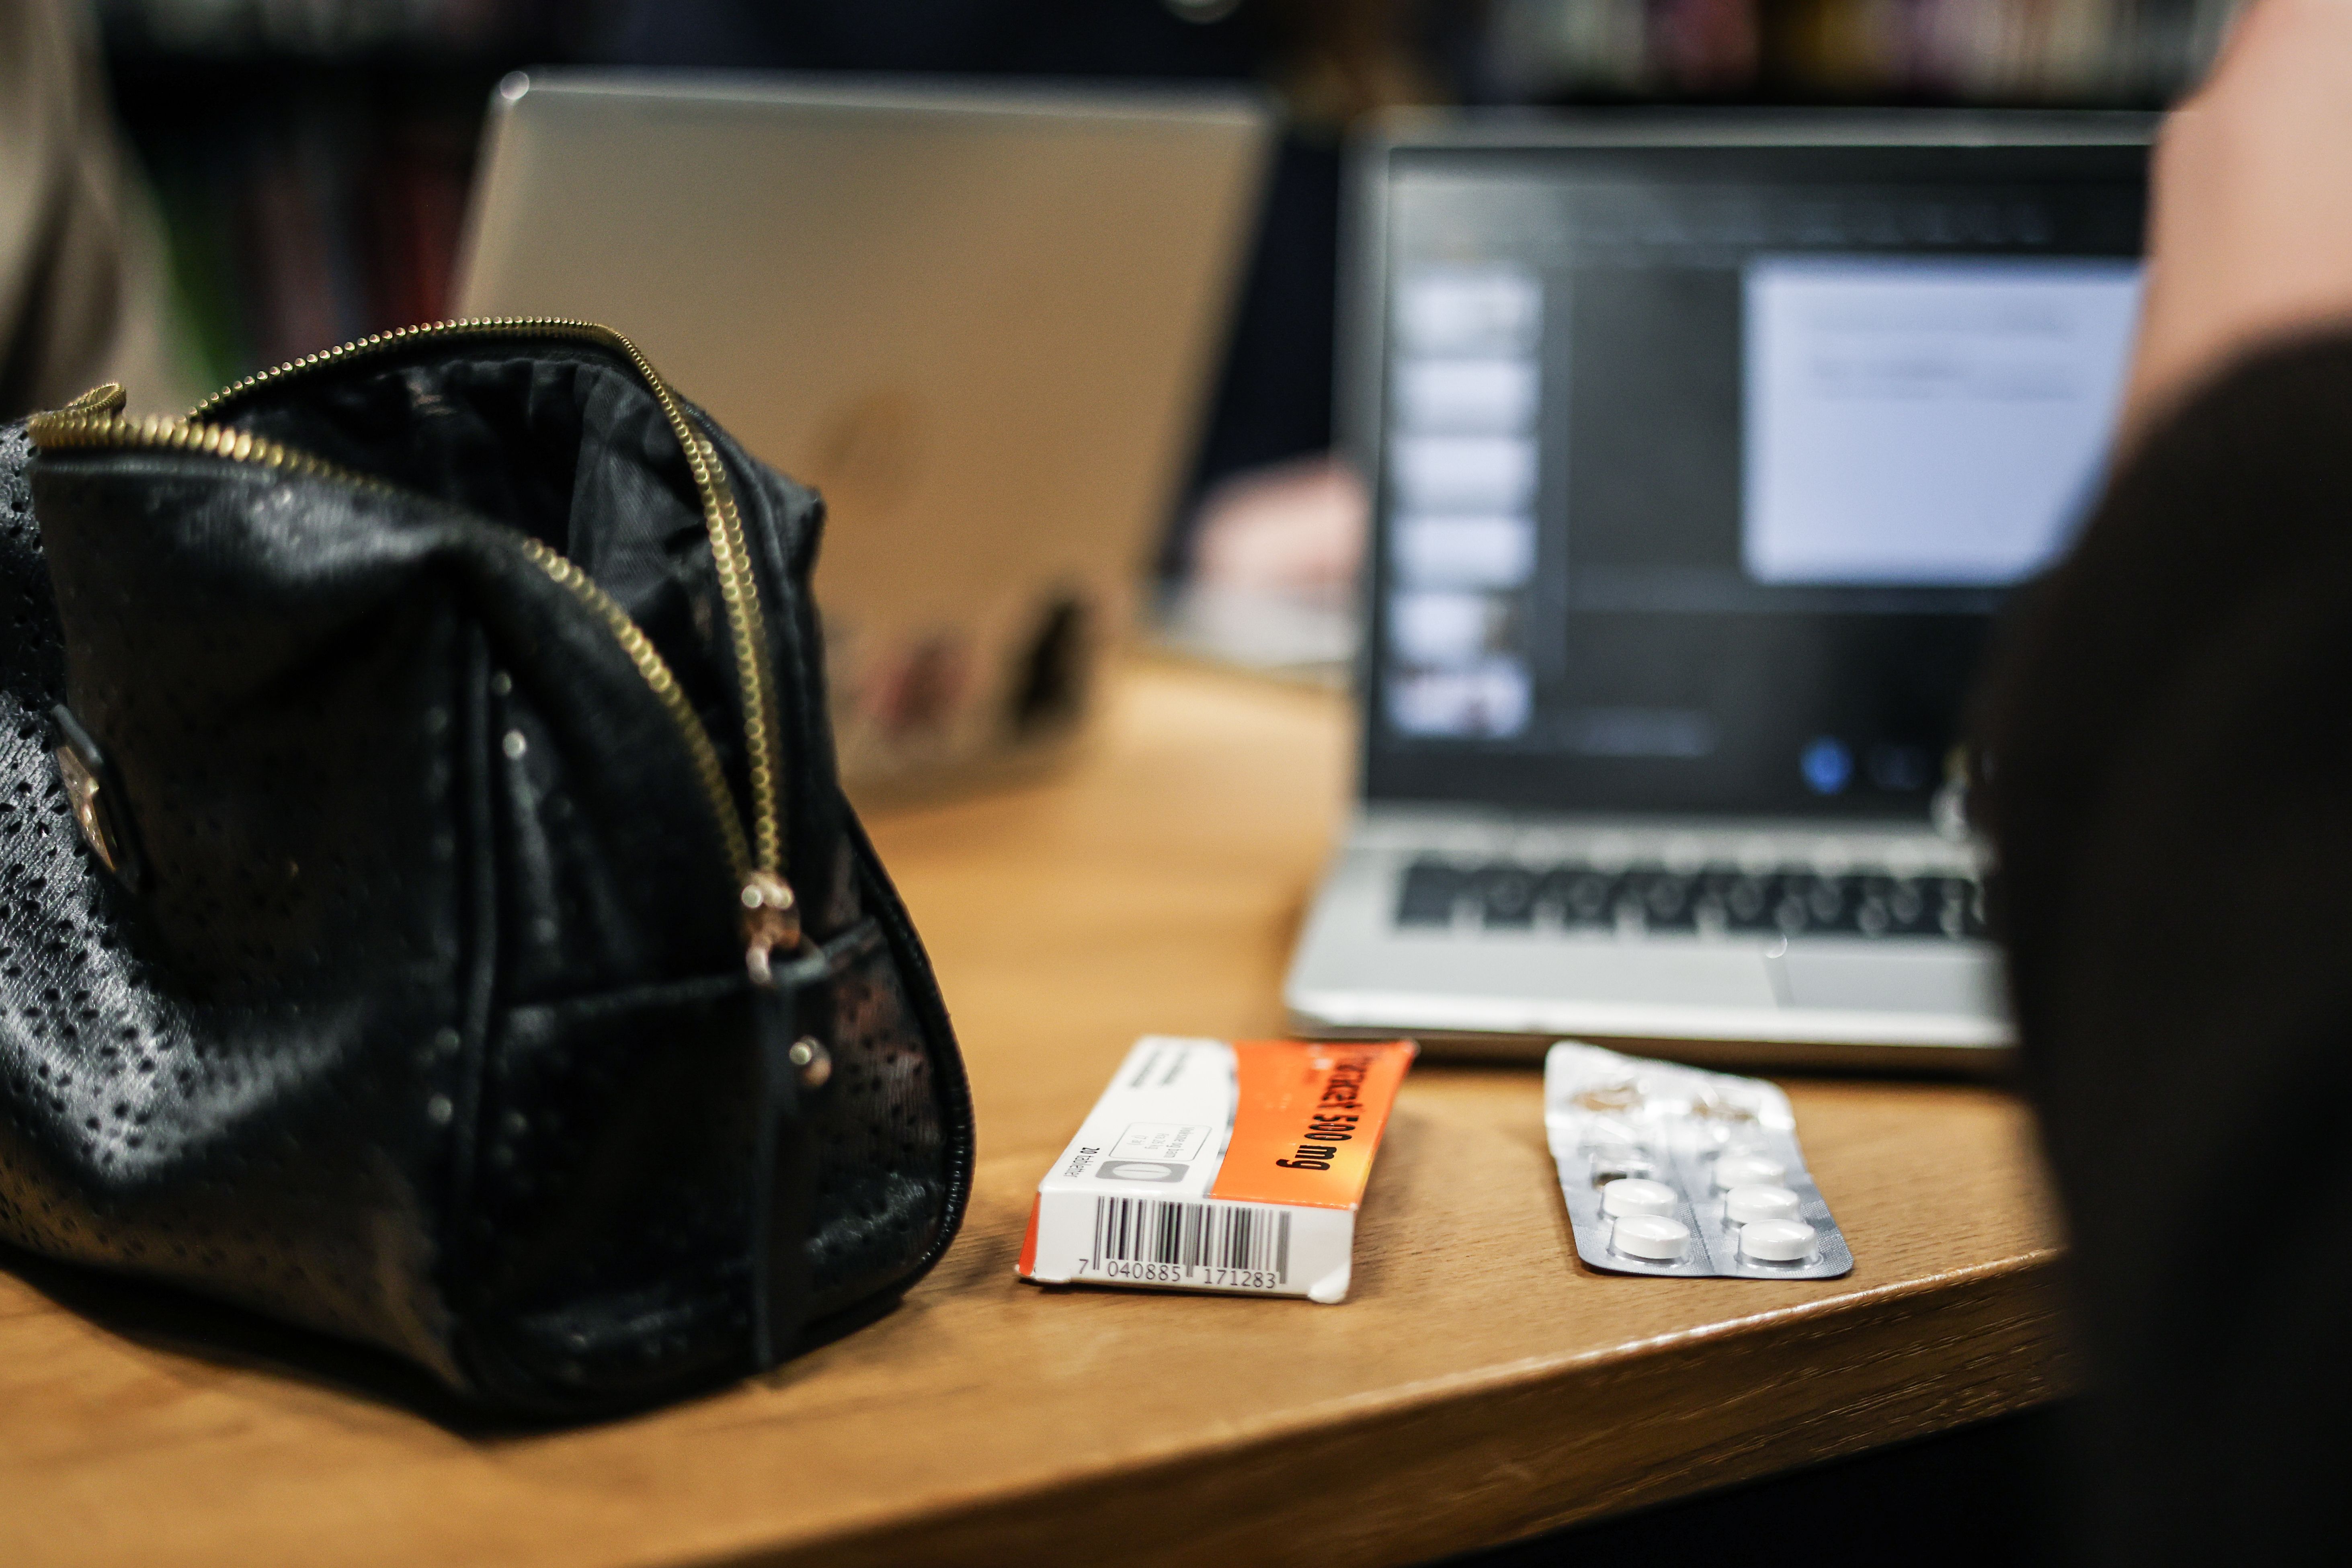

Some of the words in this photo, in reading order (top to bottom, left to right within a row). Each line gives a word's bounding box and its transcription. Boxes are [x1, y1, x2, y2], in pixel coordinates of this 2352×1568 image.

[1174, 1127, 1195, 1142] Voksne
[1304, 1113, 1360, 1141] 500
[1063, 1156, 1095, 1178] tabletter
[1275, 1145, 1337, 1171] mg
[1079, 1258, 1089, 1274] 7
[1107, 1261, 1181, 1282] 040885
[1204, 1268, 1276, 1289] 171283
